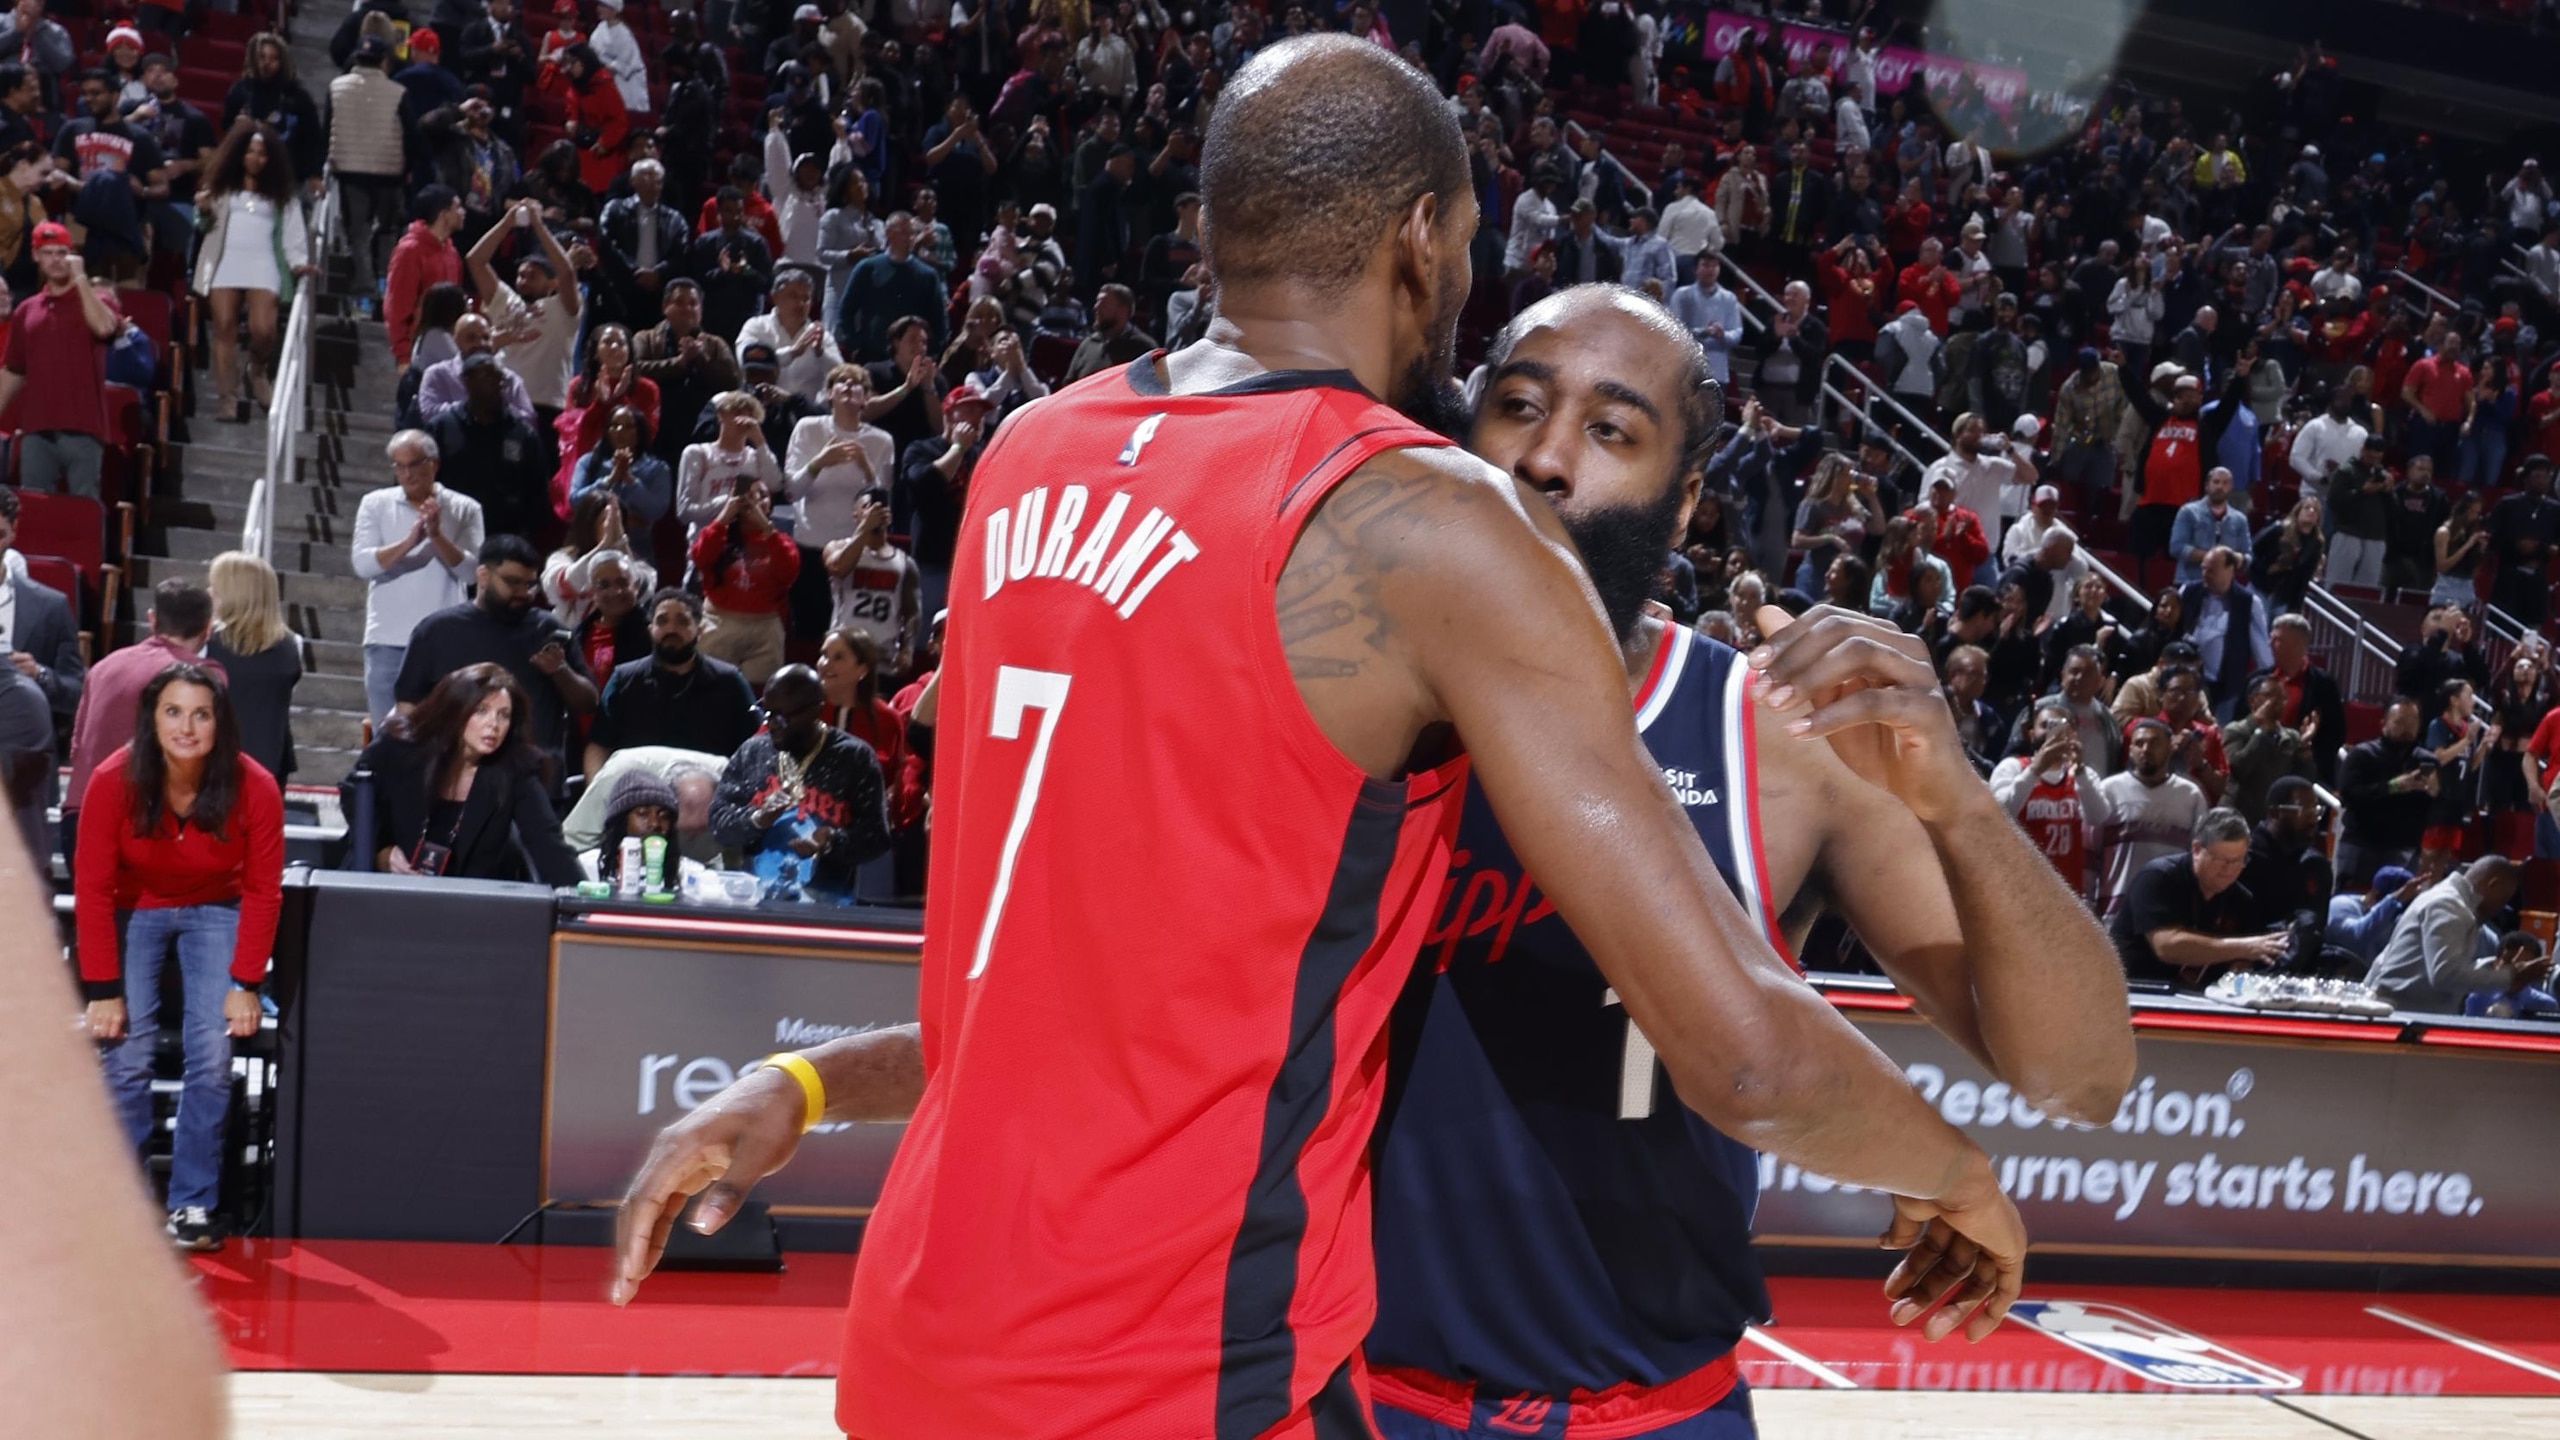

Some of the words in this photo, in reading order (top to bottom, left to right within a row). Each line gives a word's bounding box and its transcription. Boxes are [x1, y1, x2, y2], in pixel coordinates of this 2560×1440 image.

[984, 484, 1200, 620] DURANT
[853, 592, 891, 622] 28
[1661, 768, 1696, 788] SIT
[1672, 786, 1718, 806] NDA
[2027, 798, 2078, 819] ROCKET
[966, 664, 1073, 979] 7
[1991, 1153, 2158, 1221] urney
[2164, 1153, 2336, 1212] starts
[2343, 1153, 2484, 1218] here.
